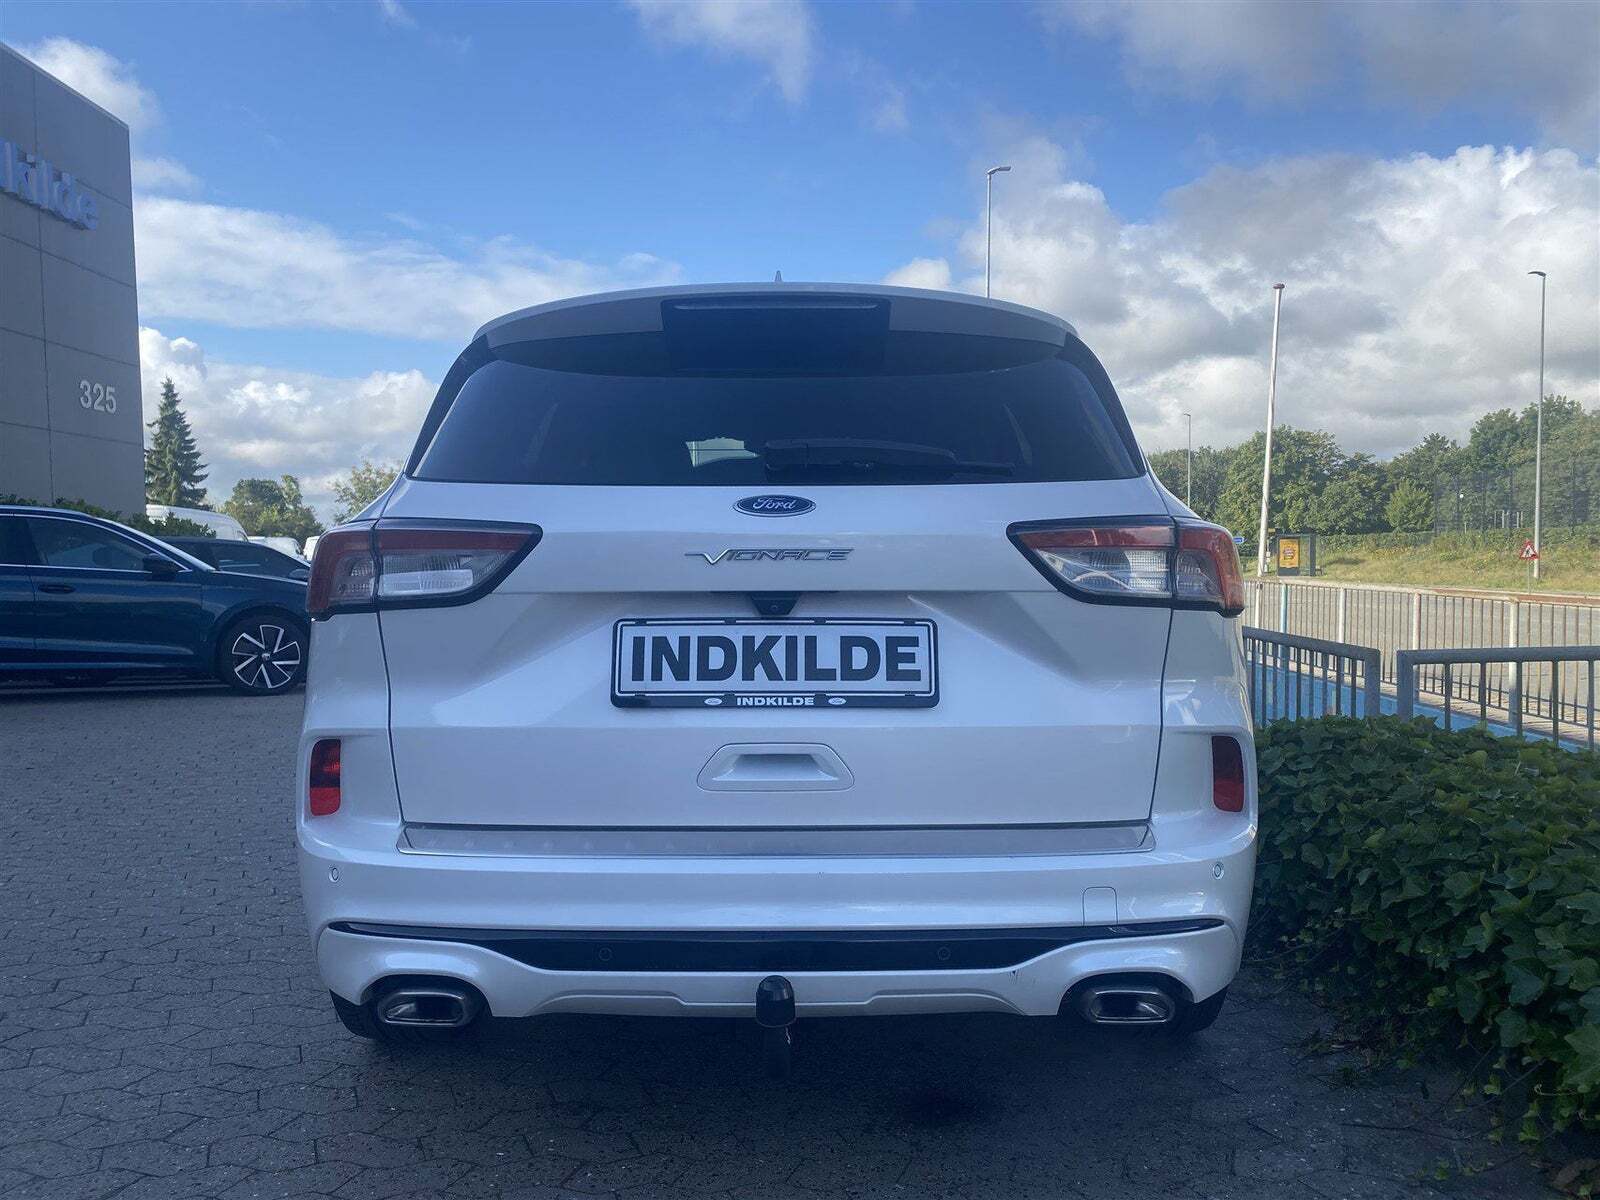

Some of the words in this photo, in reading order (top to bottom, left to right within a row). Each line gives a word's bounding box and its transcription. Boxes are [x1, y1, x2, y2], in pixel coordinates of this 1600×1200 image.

[0, 138, 97, 230] kilde
[78, 380, 117, 414] 325
[752, 497, 796, 510] Ford
[631, 635, 922, 682] INDKILDE
[736, 696, 815, 706] INDKILDE
